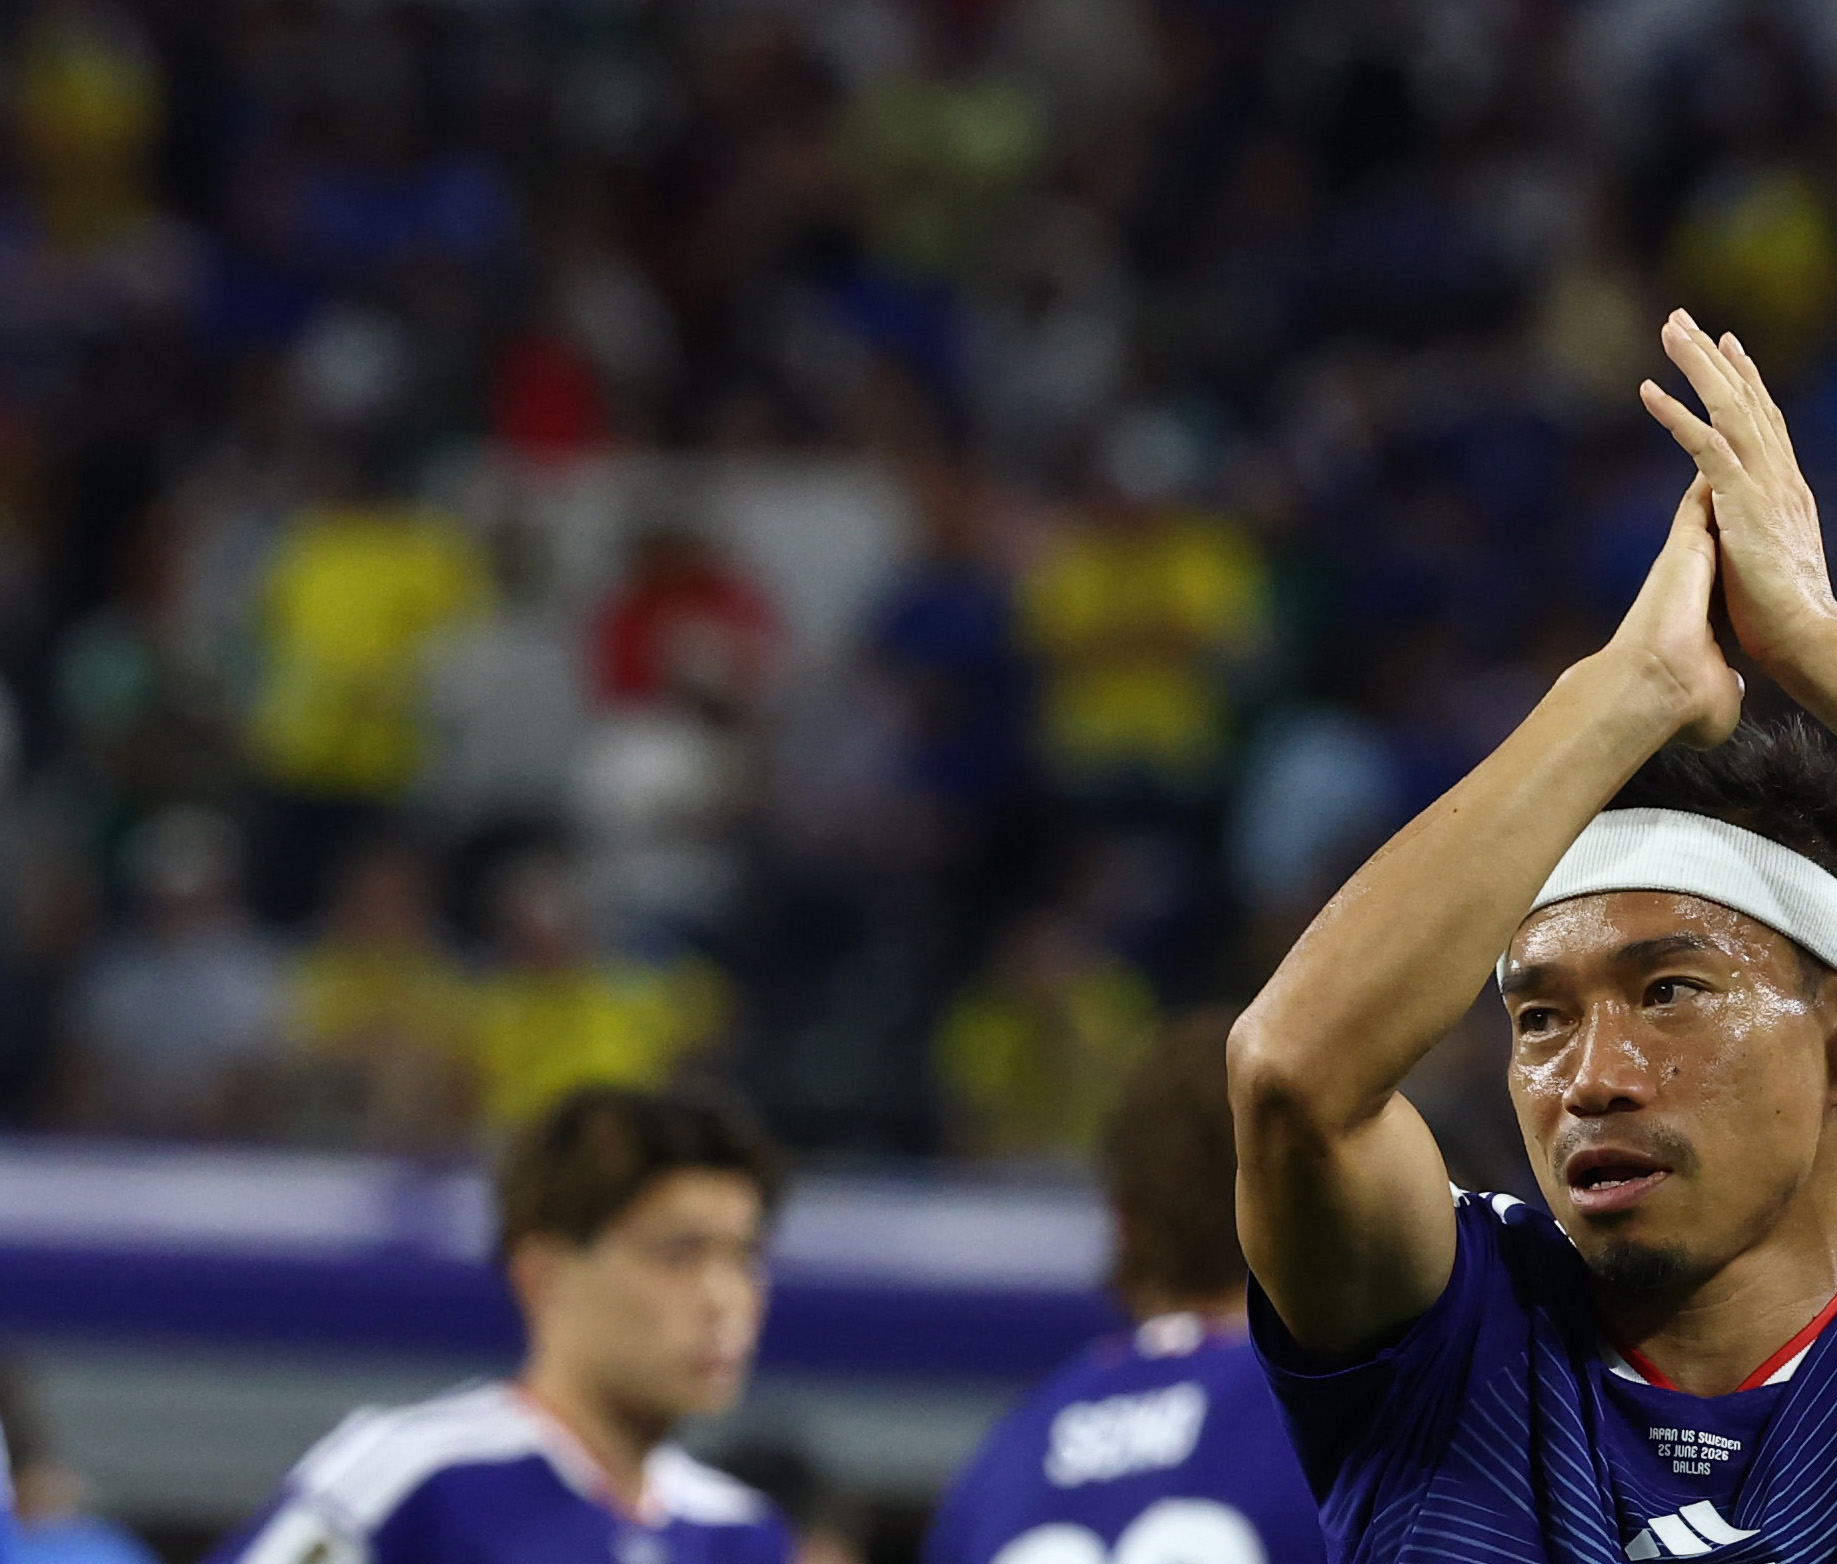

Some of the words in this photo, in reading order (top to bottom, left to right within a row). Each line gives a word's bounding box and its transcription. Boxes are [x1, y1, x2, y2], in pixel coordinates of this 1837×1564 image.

[1648, 1427, 1679, 1442] JAPAN
[1697, 1431, 1742, 1451] SWEDEN
[1657, 1443, 1672, 1457] 25
[1673, 1444, 1699, 1459] JUNE
[1700, 1446, 1730, 1461] 2026
[1672, 1460, 1711, 1475] DALLAS
